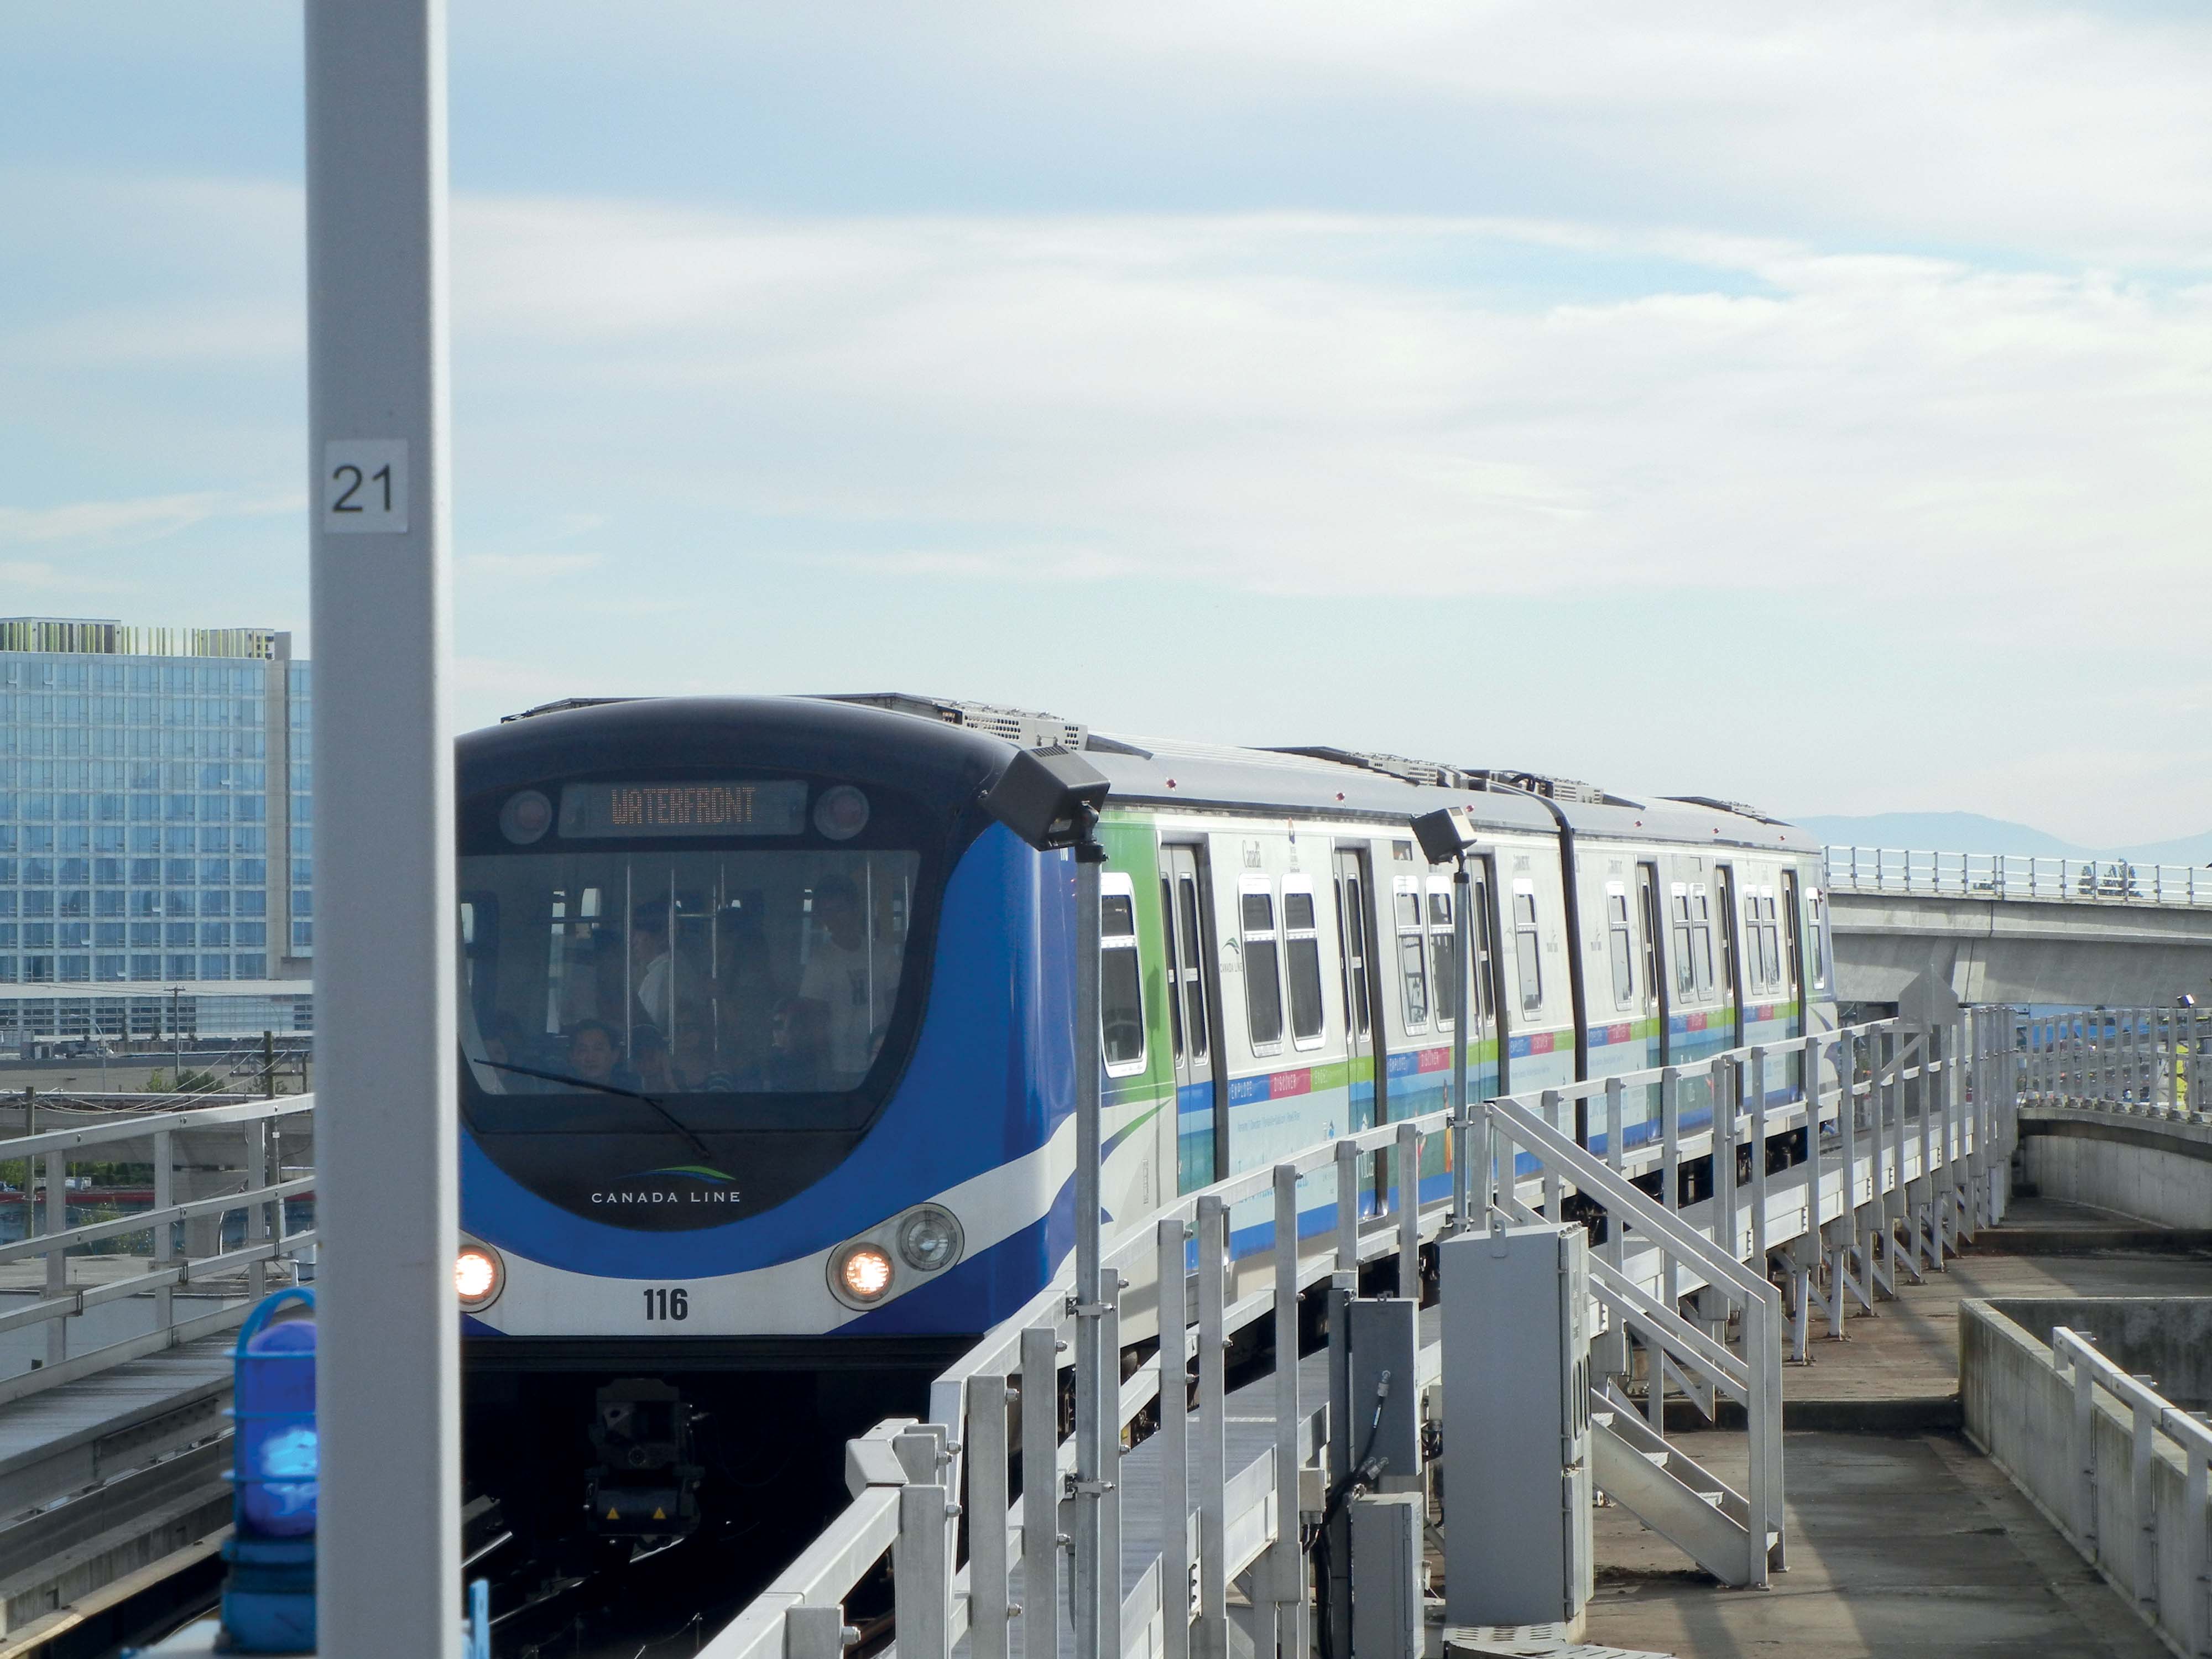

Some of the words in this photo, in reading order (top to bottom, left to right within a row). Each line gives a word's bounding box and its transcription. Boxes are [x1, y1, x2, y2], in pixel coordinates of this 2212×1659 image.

[333, 463, 391, 512] 21
[611, 787, 756, 825] WATERFRONT
[1274, 1073, 1297, 1092] DISCOVER
[591, 1191, 678, 1204] CANADA
[690, 1191, 741, 1203] LINE
[643, 1288, 688, 1321] 116
